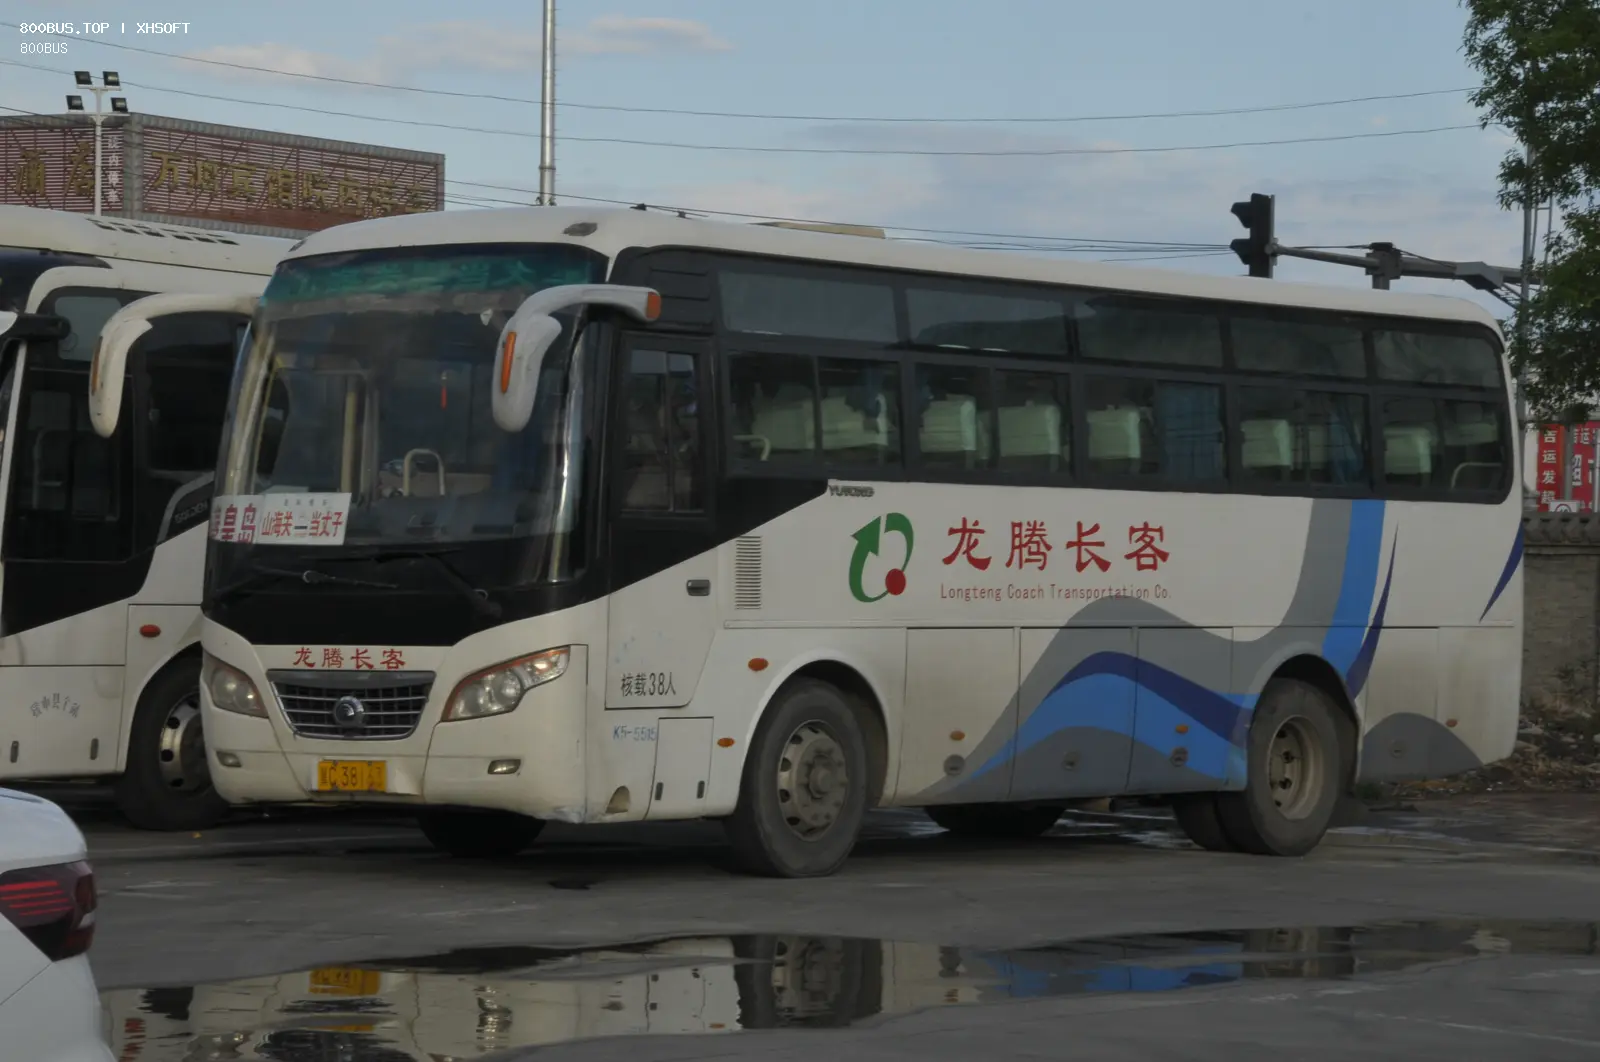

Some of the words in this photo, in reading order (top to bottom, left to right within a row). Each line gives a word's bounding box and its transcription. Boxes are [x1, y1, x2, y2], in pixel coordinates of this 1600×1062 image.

[942, 517, 1170, 572] 龙腾长客
[940, 583, 1002, 601] Longteng
[1007, 583, 1045, 599] Coach
[1050, 583, 1150, 601] Transportation
[1154, 584, 1172, 599] Co.
[292, 647, 406, 669] 龙腾长客
[620, 672, 677, 697] 核载38人
